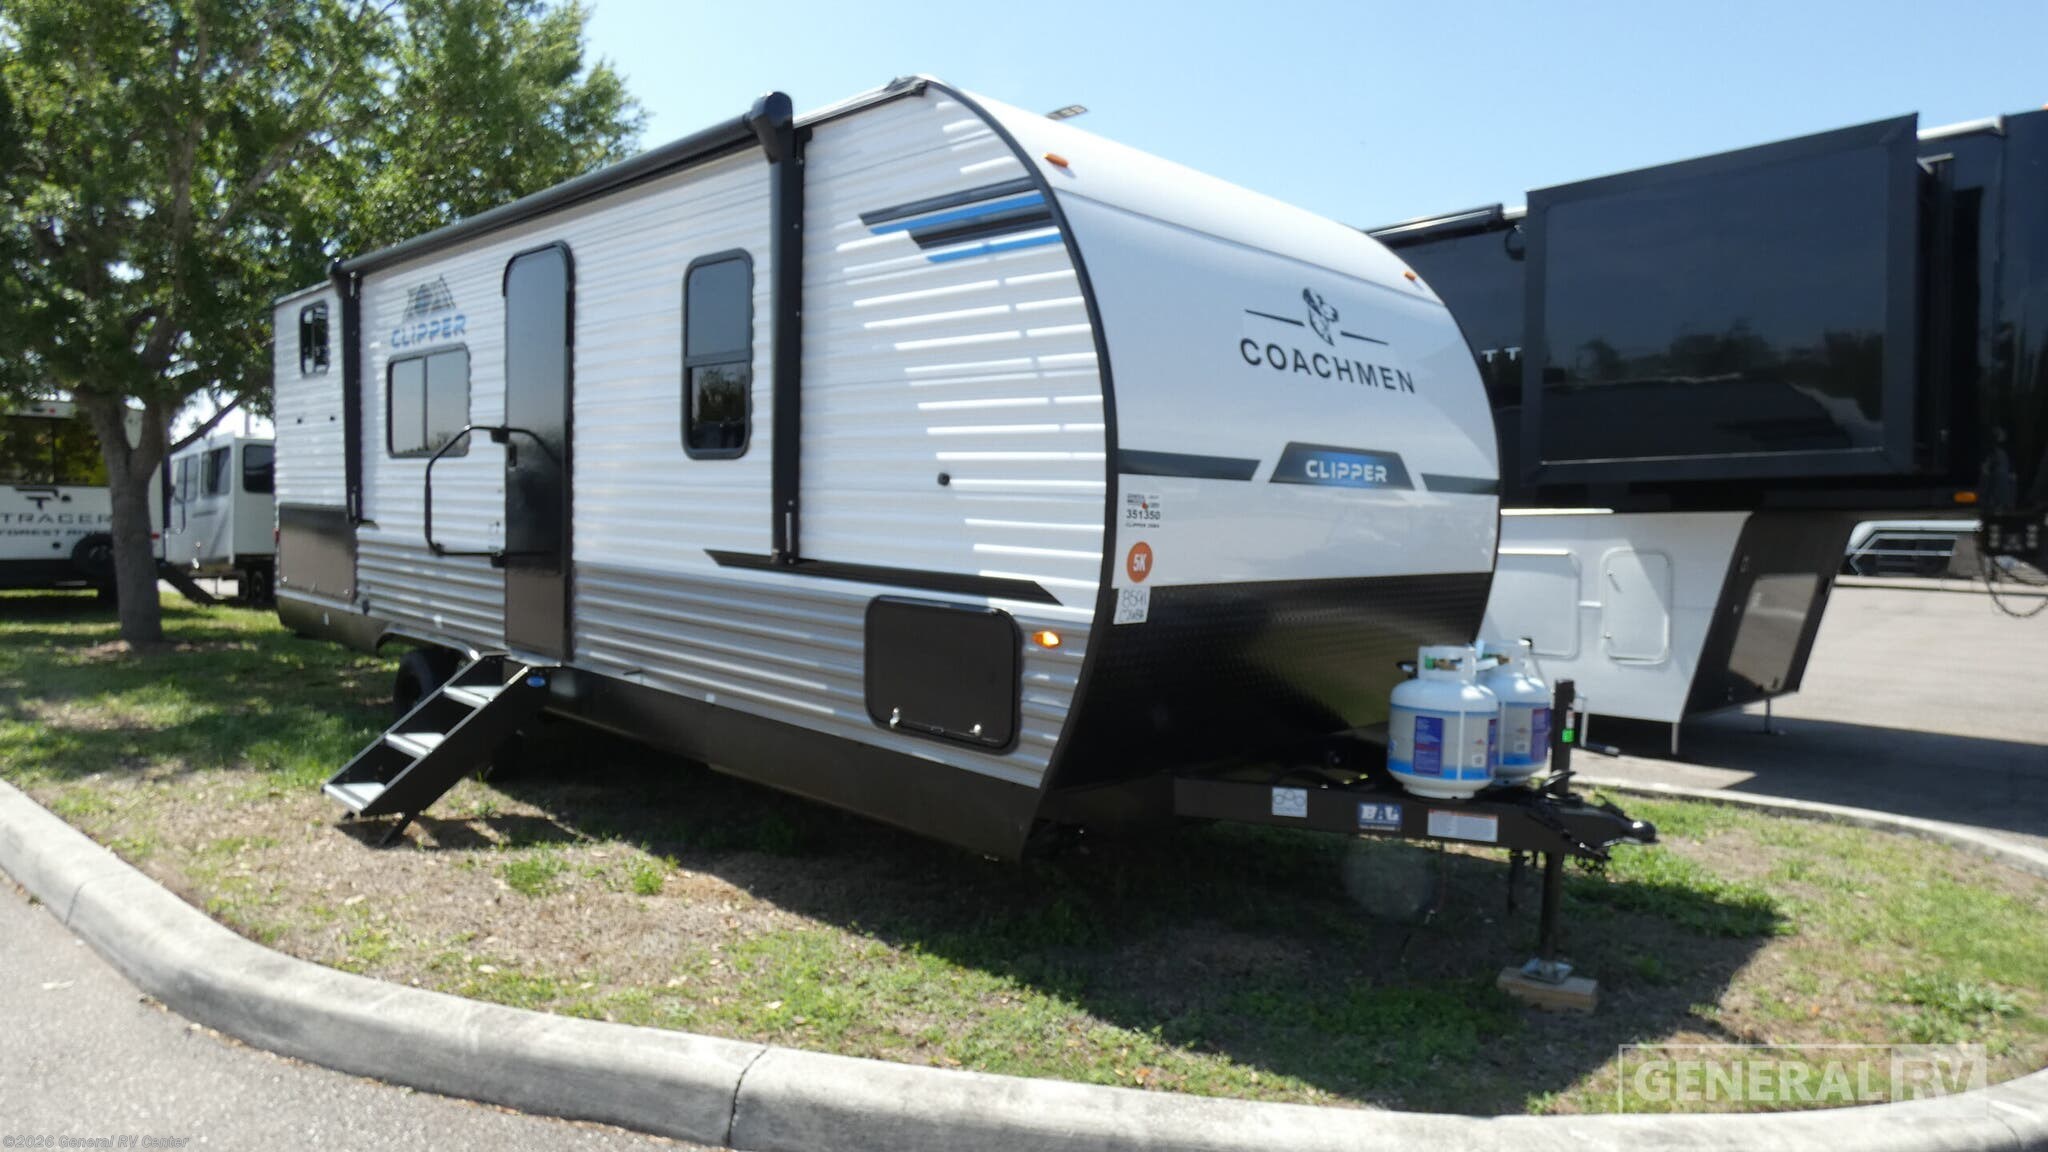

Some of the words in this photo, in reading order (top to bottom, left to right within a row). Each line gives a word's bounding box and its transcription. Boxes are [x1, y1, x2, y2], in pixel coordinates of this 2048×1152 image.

[391, 314, 466, 347] CLIPPER
[1240, 338, 1416, 394] COACHMEN
[1305, 459, 1388, 483] CLIPPER
[0, 512, 111, 524] TRACER
[1133, 553, 1147, 572] 5K
